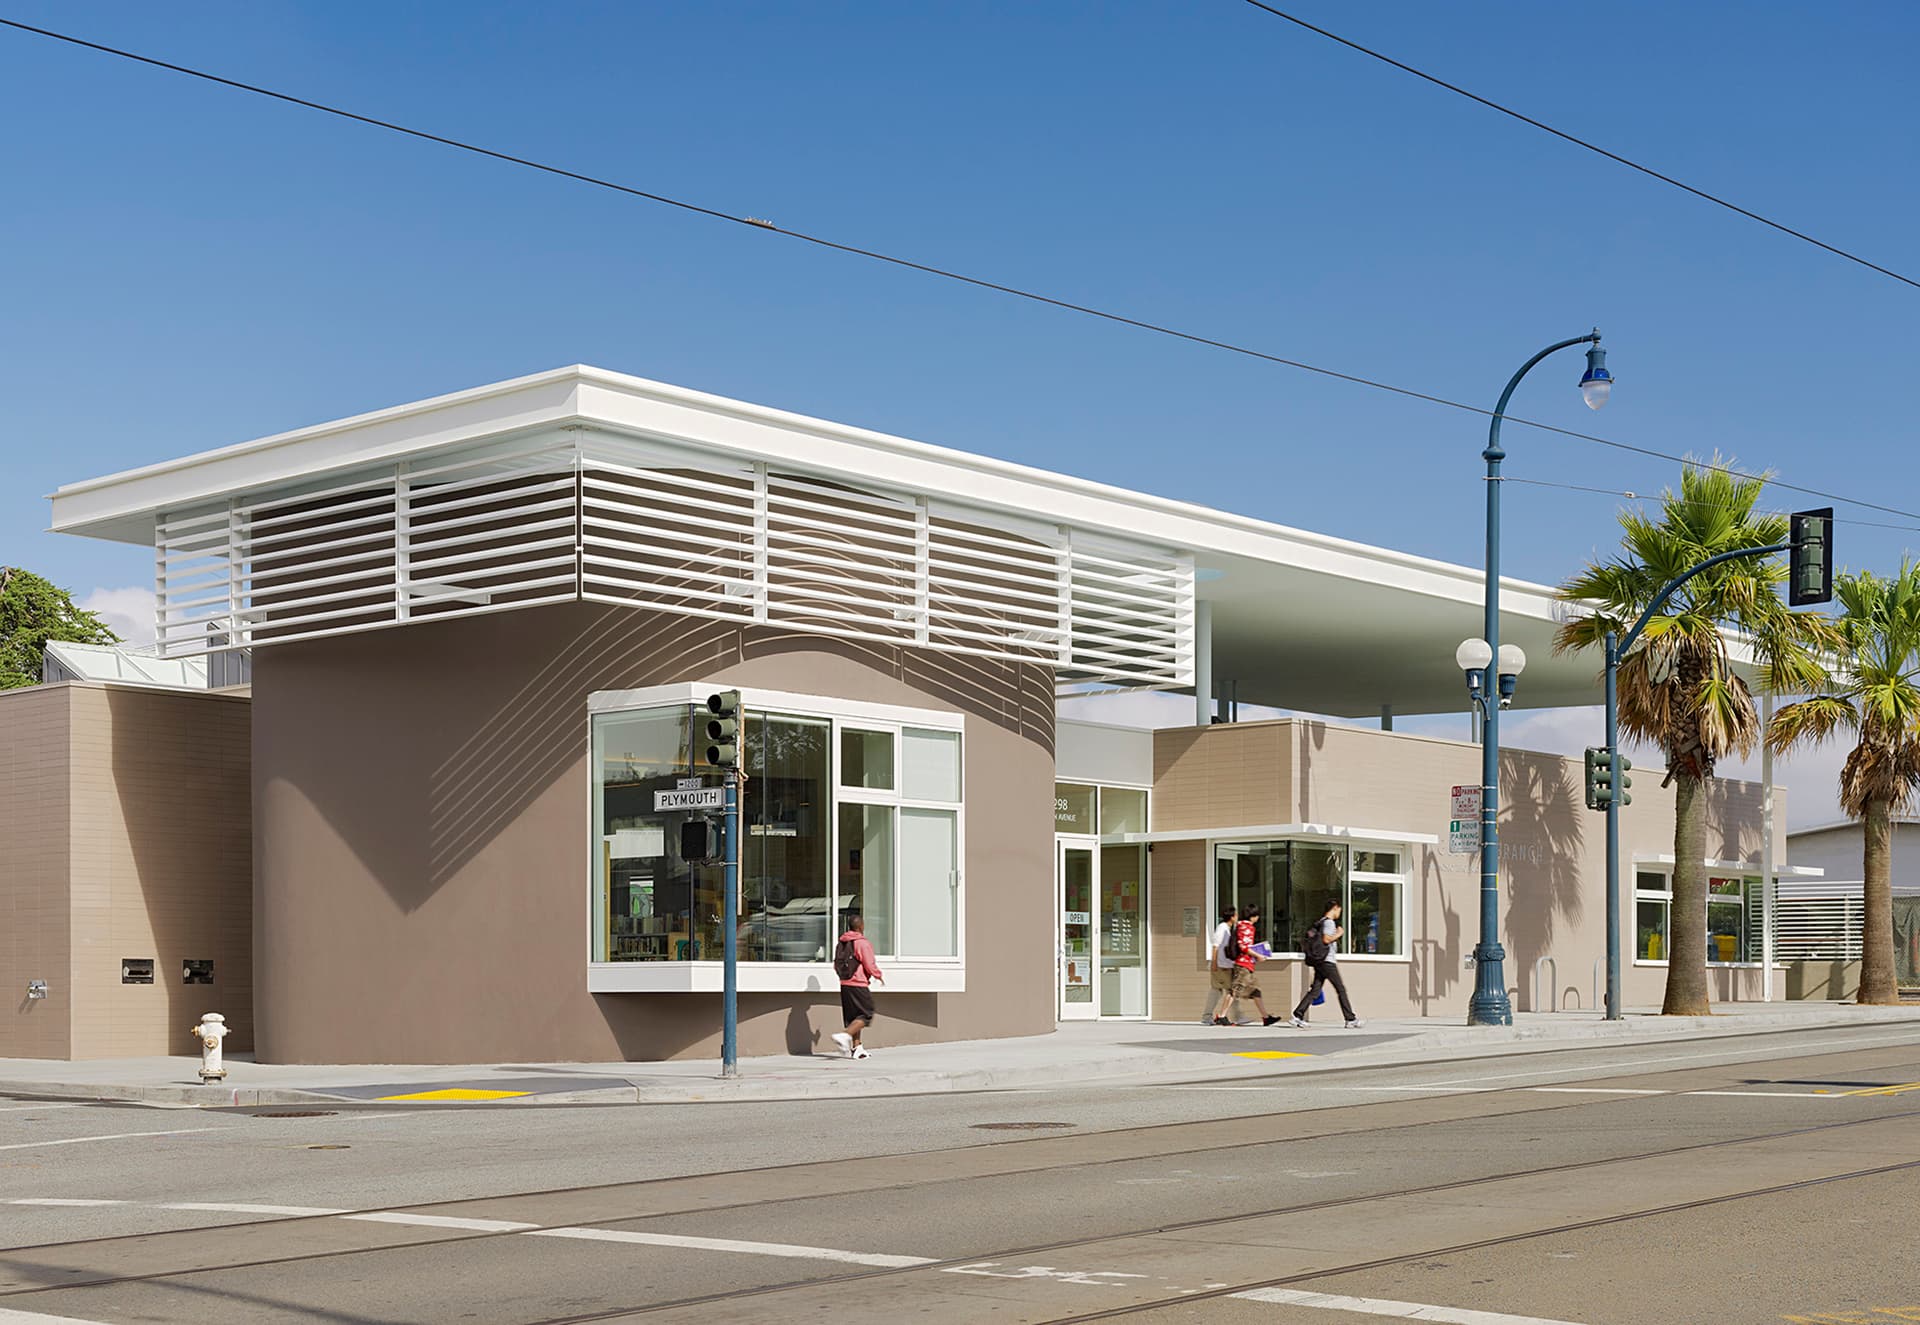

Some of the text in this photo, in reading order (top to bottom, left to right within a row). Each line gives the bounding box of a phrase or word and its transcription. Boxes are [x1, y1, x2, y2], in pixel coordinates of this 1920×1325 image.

[661, 792, 717, 806] PLYMOUTH
[1452, 822, 1457, 831] 1
[1070, 913, 1084, 922] OPEN
